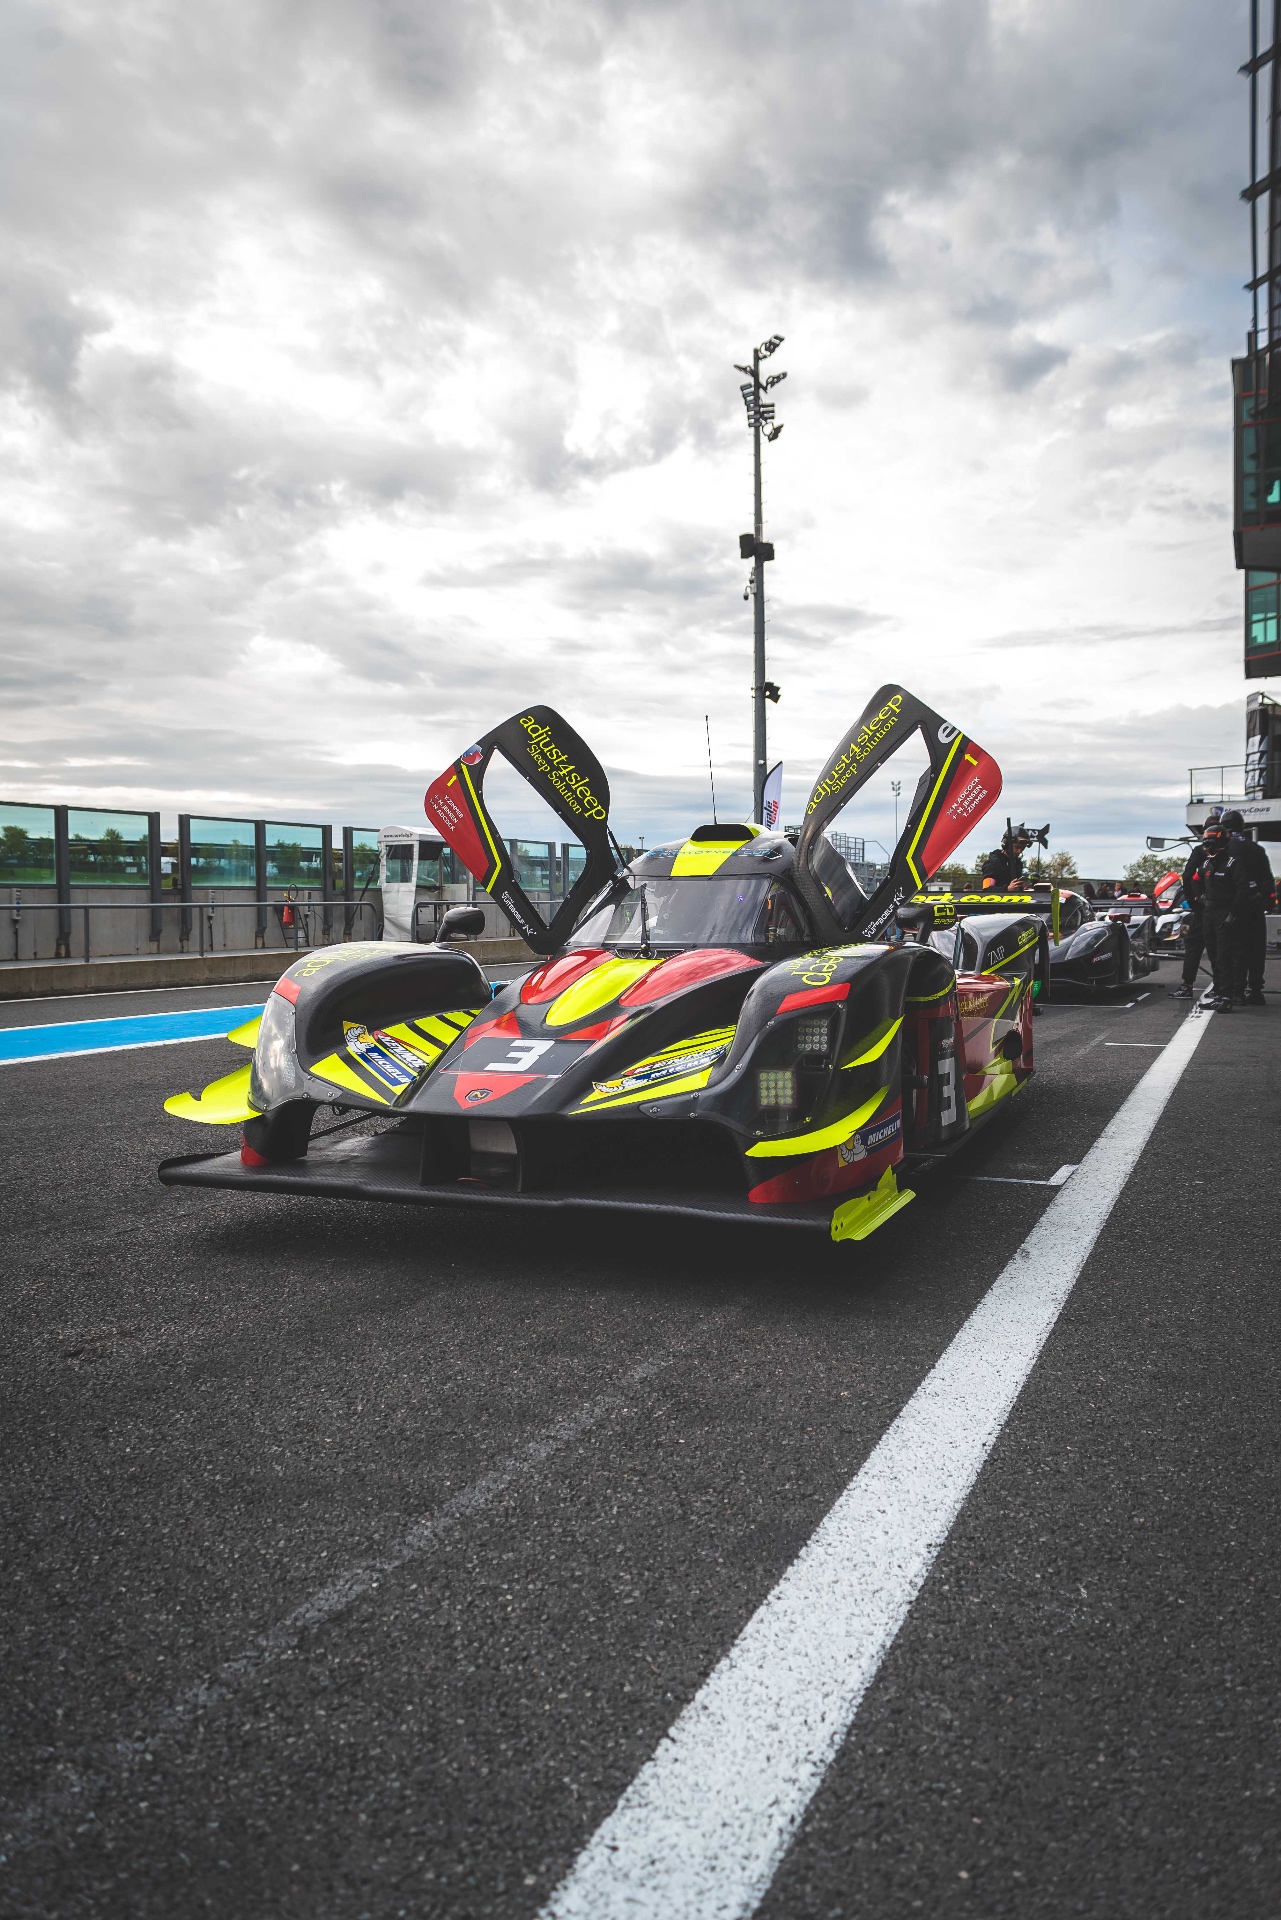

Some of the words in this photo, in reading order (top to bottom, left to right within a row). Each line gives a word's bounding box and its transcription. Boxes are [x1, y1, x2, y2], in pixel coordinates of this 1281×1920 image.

[519, 715, 606, 820] adjust4sleep
[806, 694, 903, 815] adjust4sleep
[483, 1039, 555, 1071] 3
[937, 1057, 957, 1127] 3
